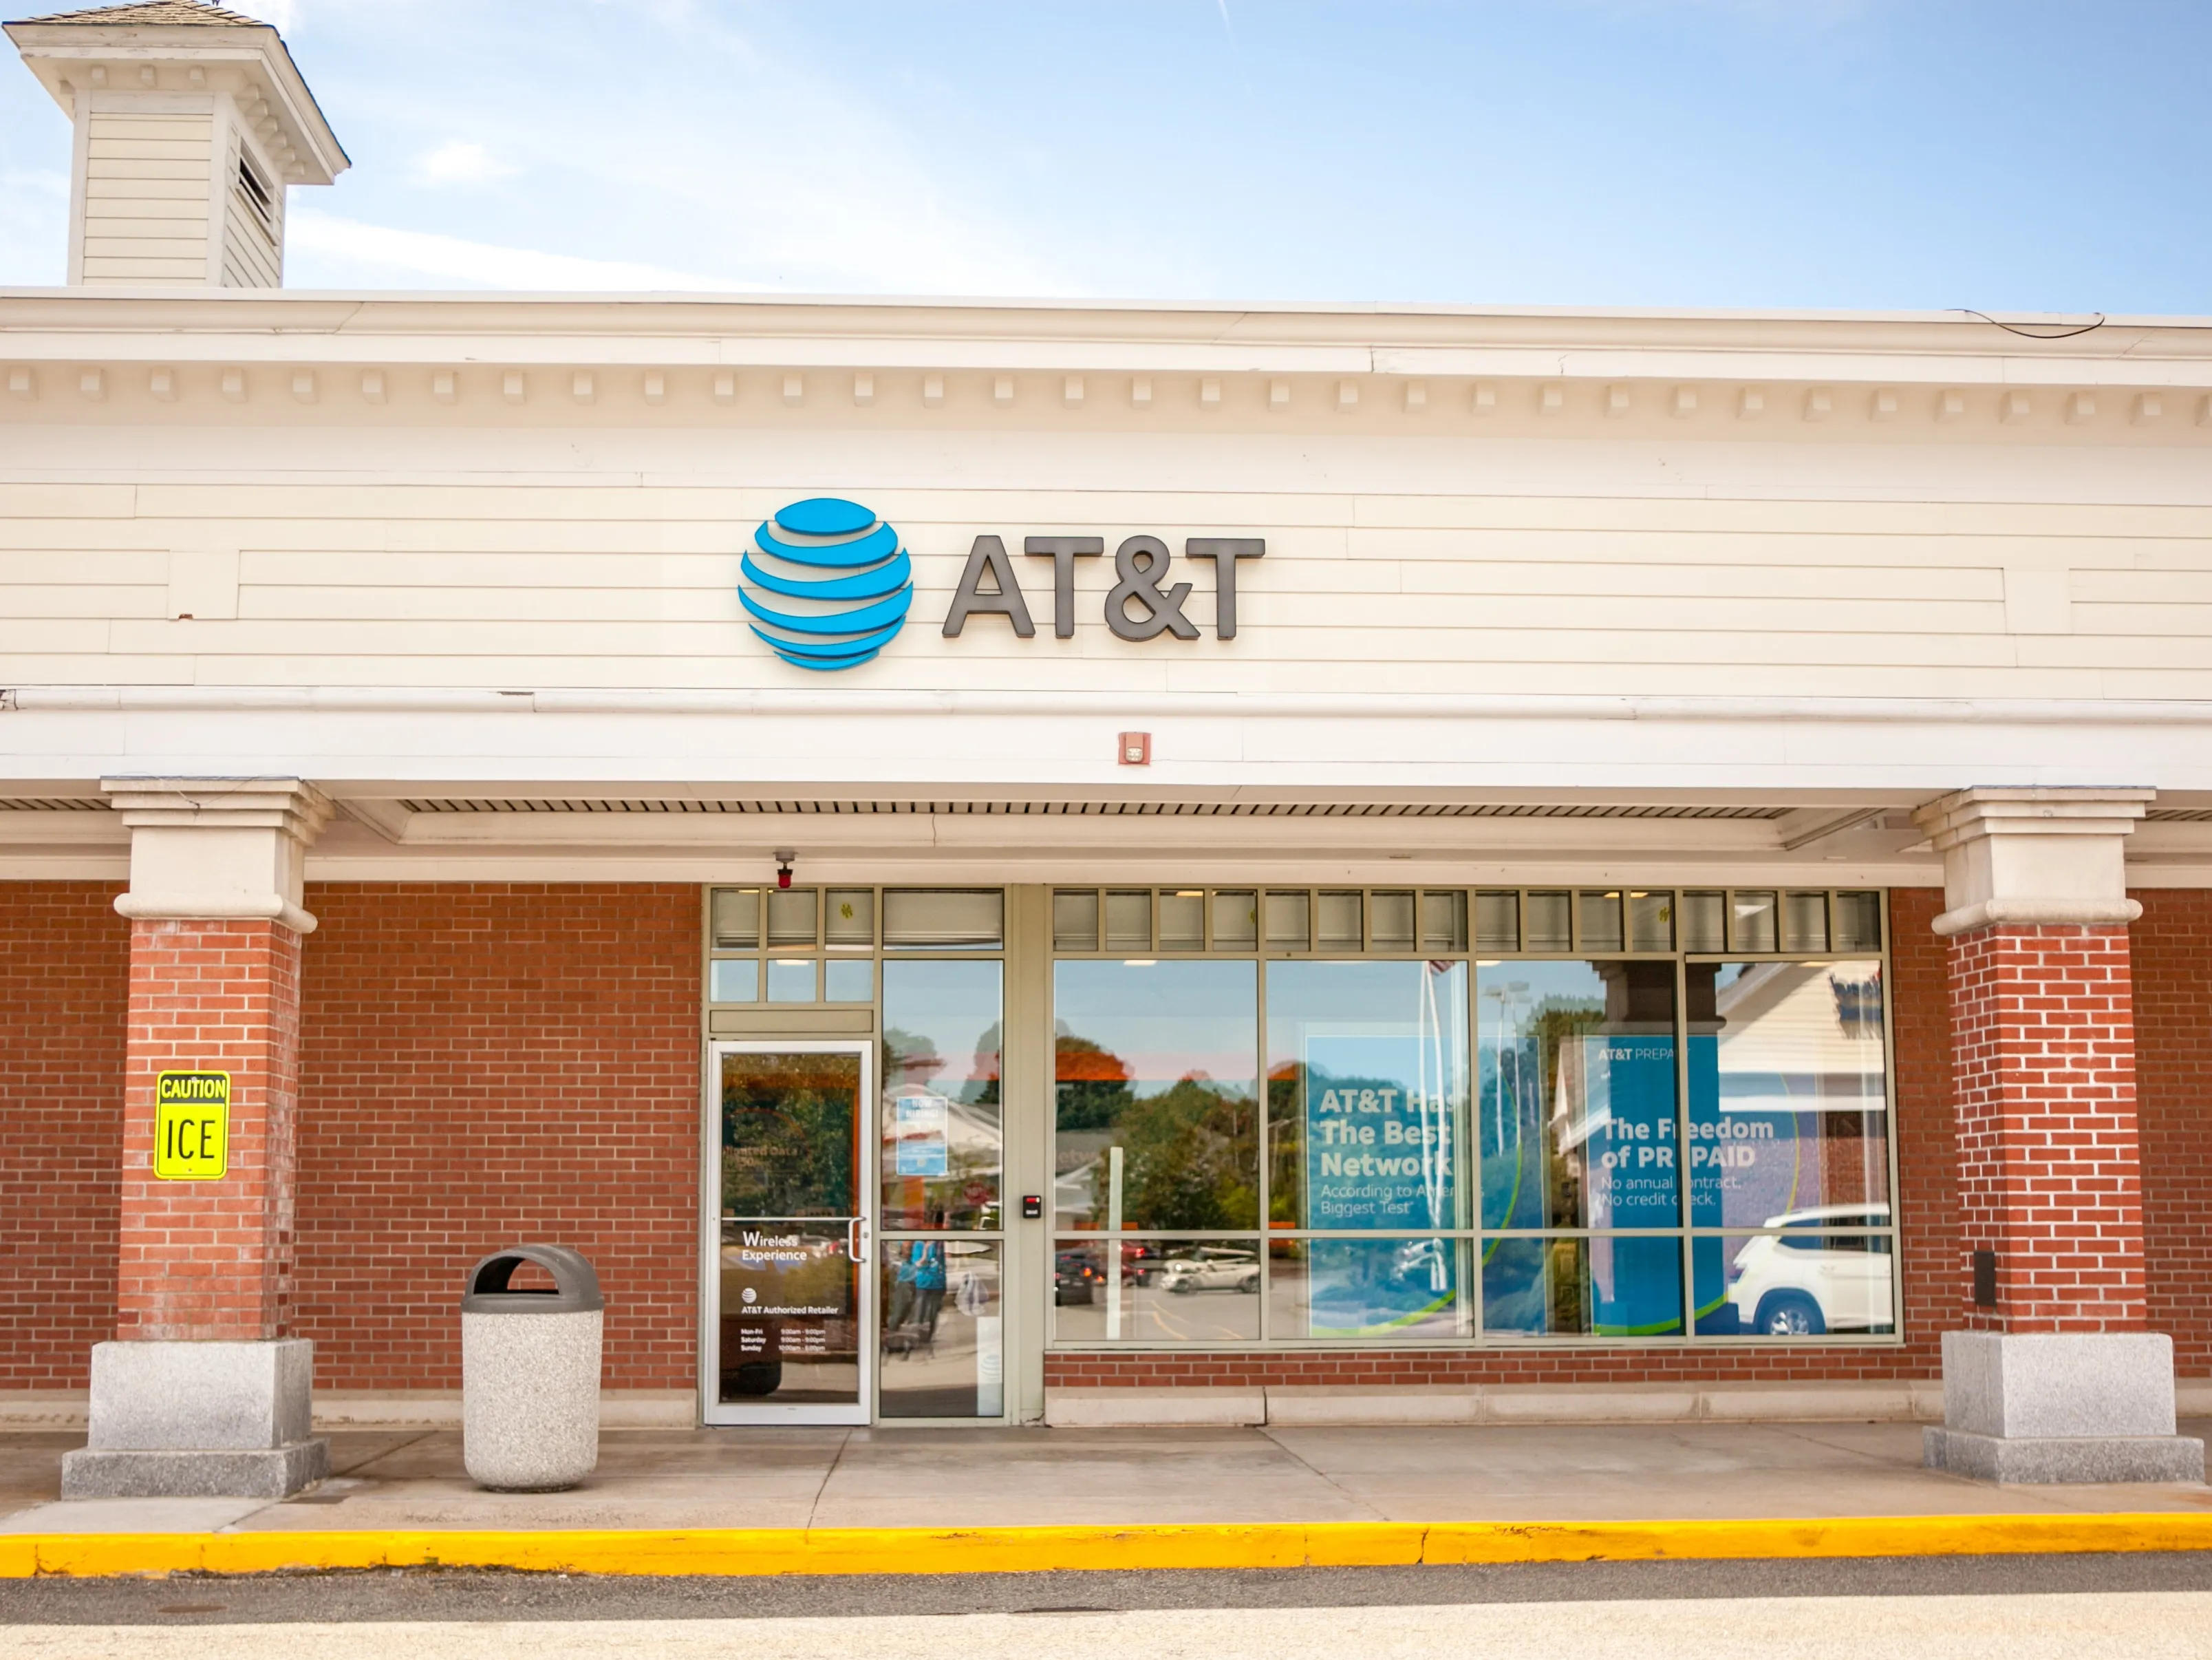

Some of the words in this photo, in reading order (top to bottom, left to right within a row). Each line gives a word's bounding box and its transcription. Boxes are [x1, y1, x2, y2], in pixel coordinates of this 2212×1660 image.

[942, 535, 1266, 642] AT&T
[1598, 1048, 1632, 1060] AT&T
[1635, 1047, 1682, 1061] PREPA
[161, 1079, 226, 1098] CAUTION
[1320, 1089, 1397, 1113] AT&T
[1320, 1120, 1375, 1145] The
[1384, 1120, 1451, 1145] Best
[1604, 1117, 1650, 1140] The
[167, 1120, 215, 1159] ICE
[1320, 1151, 1453, 1176] Network
[1601, 1145, 1631, 1169] of
[1638, 1146, 1755, 1168] PRPAID
[1601, 1177, 1622, 1189] No
[1626, 1175, 1673, 1189] annual
[1321, 1183, 1393, 1201] According
[1397, 1184, 1413, 1198] to
[1602, 1193, 1622, 1206] No
[1626, 1192, 1667, 1206] credit
[1671, 1192, 1716, 1206] ceck.
[1321, 1201, 1375, 1217] Biggest
[742, 1231, 798, 1247] Wireless
[742, 1249, 808, 1263] Experience
[742, 1306, 762, 1315] AT&T
[764, 1306, 808, 1315] Authorized
[808, 1306, 839, 1315] Retailer
